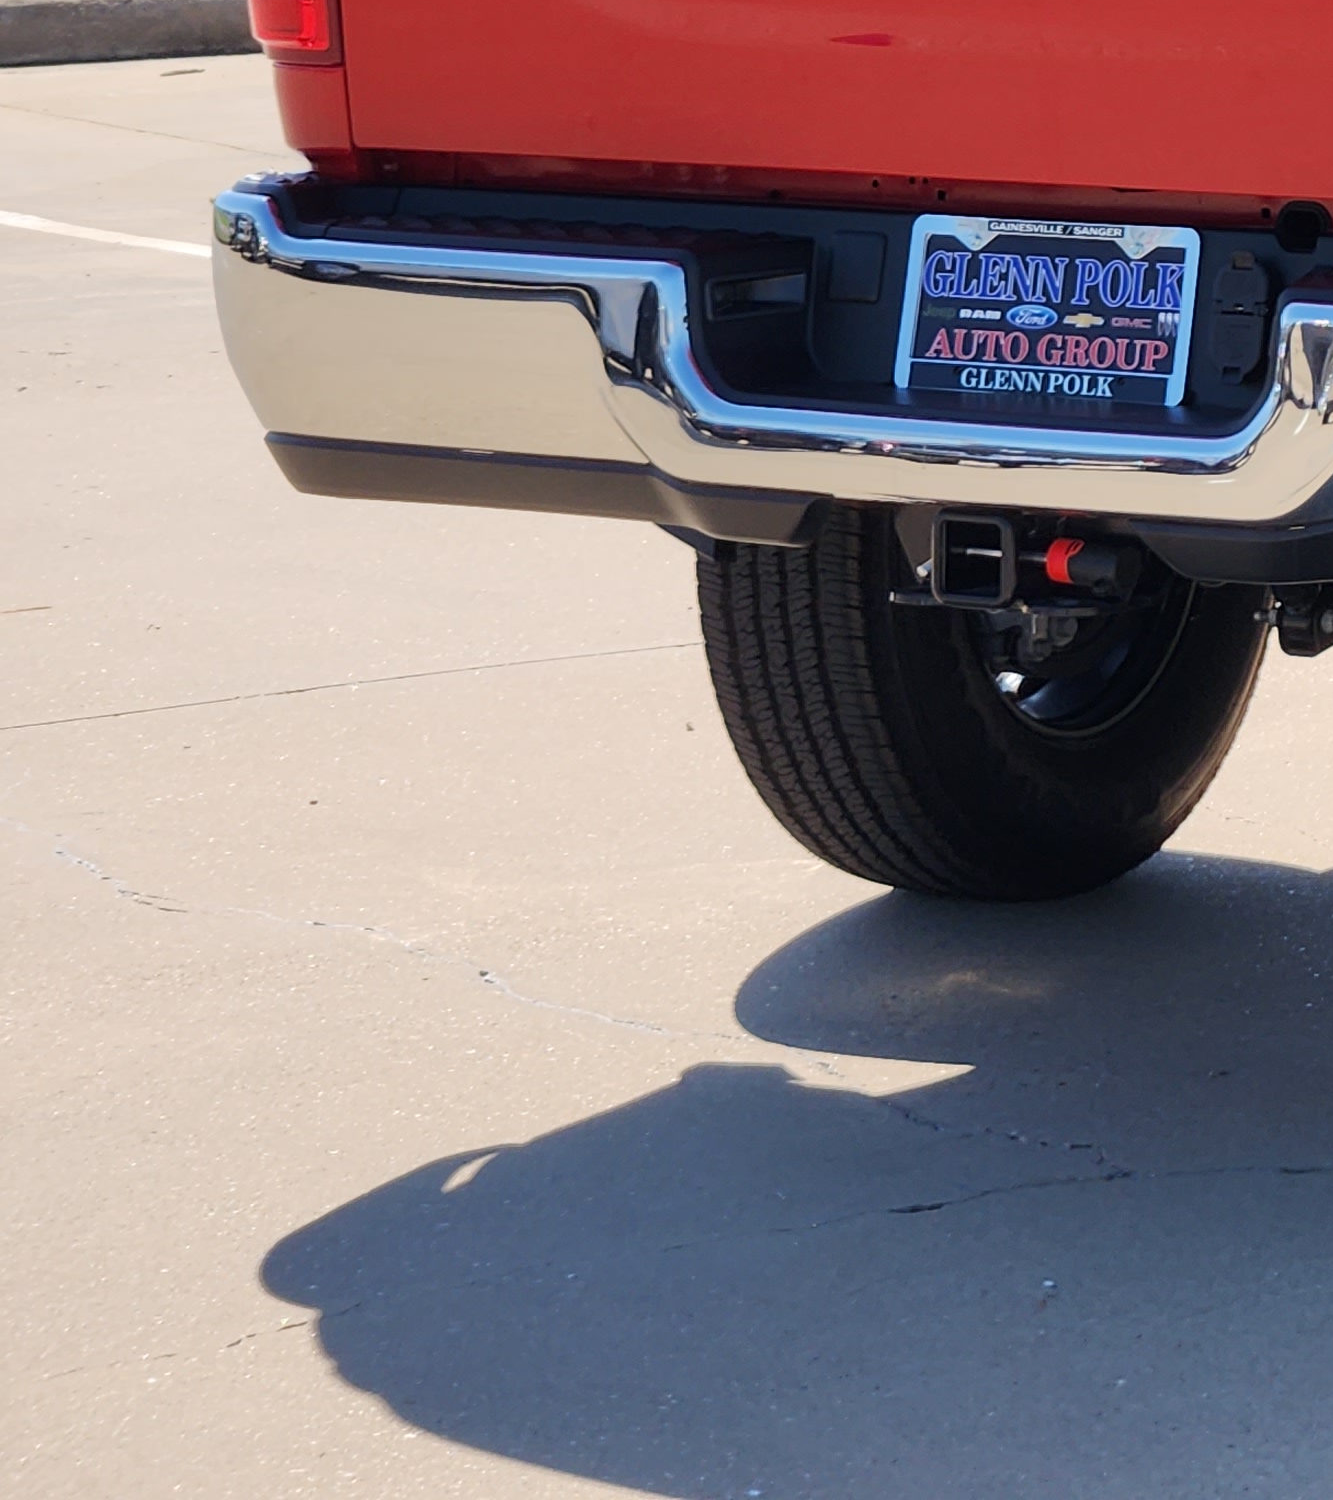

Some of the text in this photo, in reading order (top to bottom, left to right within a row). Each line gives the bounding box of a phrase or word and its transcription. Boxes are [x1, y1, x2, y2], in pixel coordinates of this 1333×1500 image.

[989, 221, 1064, 235] GAINESVILLE
[1073, 226, 1123, 237] SANGER
[923, 250, 1185, 310] GLENN POLK
[959, 308, 1002, 320] RAM
[1111, 316, 1152, 329] GMC
[924, 327, 1169, 371] AUTO GROUP
[959, 366, 1115, 397] GLENN POLK
